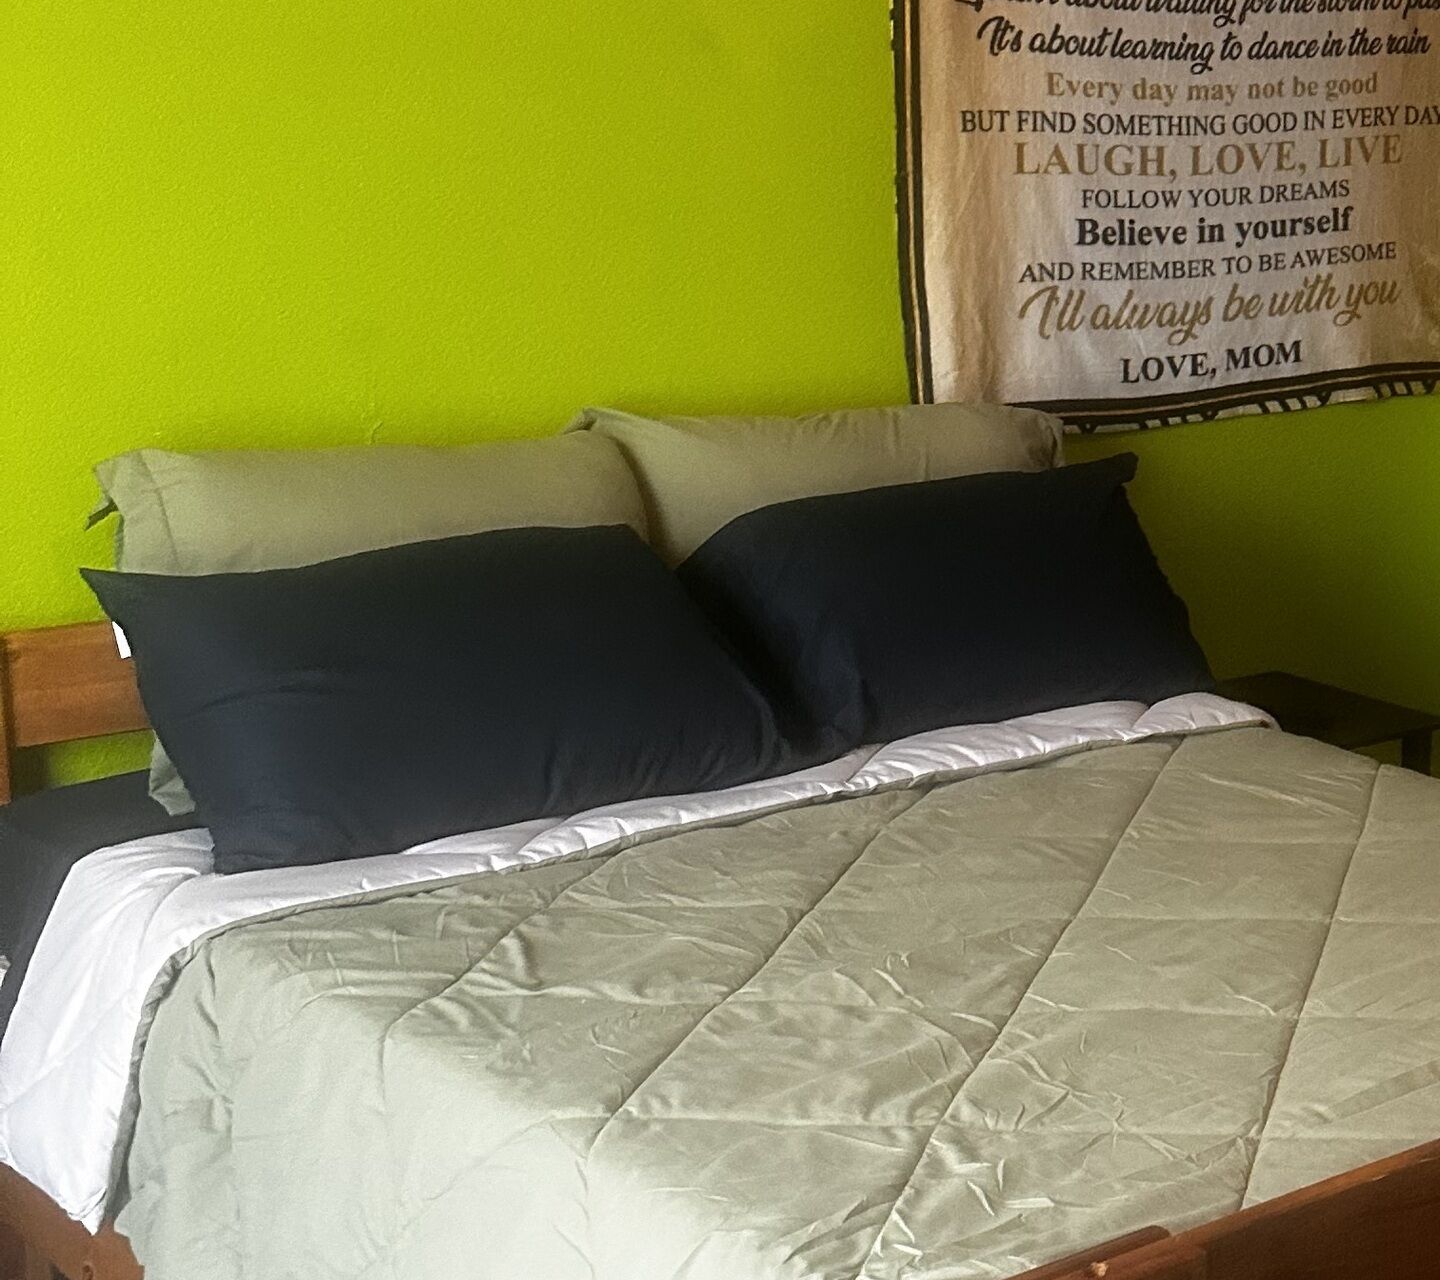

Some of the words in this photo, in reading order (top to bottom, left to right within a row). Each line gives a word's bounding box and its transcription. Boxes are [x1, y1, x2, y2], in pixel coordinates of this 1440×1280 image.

[976, 16, 1023, 56] It's
[1028, 23, 1112, 56] about
[1110, 27, 1213, 74] learning
[1220, 31, 1243, 61] to
[1247, 31, 1319, 60] dance
[1321, 29, 1346, 57] in
[1347, 27, 1383, 56] the
[1386, 27, 1431, 55] rain
[1047, 72, 1122, 105] Every
[1132, 77, 1178, 107] day
[1186, 82, 1239, 106] may
[1247, 78, 1284, 99] not
[1292, 76, 1320, 97] be
[1325, 72, 1378, 102] good
[961, 110, 1010, 133] BUT
[1016, 111, 1076, 133] FIND
[1082, 113, 1226, 136] SOMETHING
[1232, 112, 1297, 135] GOOD
[1303, 110, 1326, 131] IN
[1331, 106, 1399, 129] EVERY
[1013, 142, 1177, 183] LAUGH,
[1190, 140, 1307, 177] LOVE,
[1318, 134, 1402, 168] LIVE
[1082, 188, 1182, 208] FOLLOW
[1188, 187, 1253, 208] YOUR
[1259, 179, 1350, 204] DREAMS
[1075, 218, 1187, 246] Believe
[1197, 217, 1225, 244] in
[1235, 205, 1354, 248] yourself
[1018, 262, 1074, 283] AND
[1081, 258, 1216, 281] REMEMBER
[1222, 256, 1252, 275] TO
[1258, 253, 1286, 271] BE
[1290, 241, 1397, 269] AWESOME
[1018, 285, 1086, 340] I'll
[1090, 289, 1215, 346] always
[1222, 283, 1264, 322] be
[1268, 273, 1340, 317] with
[1333, 280, 1401, 326] you
[1120, 352, 1217, 384] LOVE,
[1225, 340, 1302, 371] MOM
